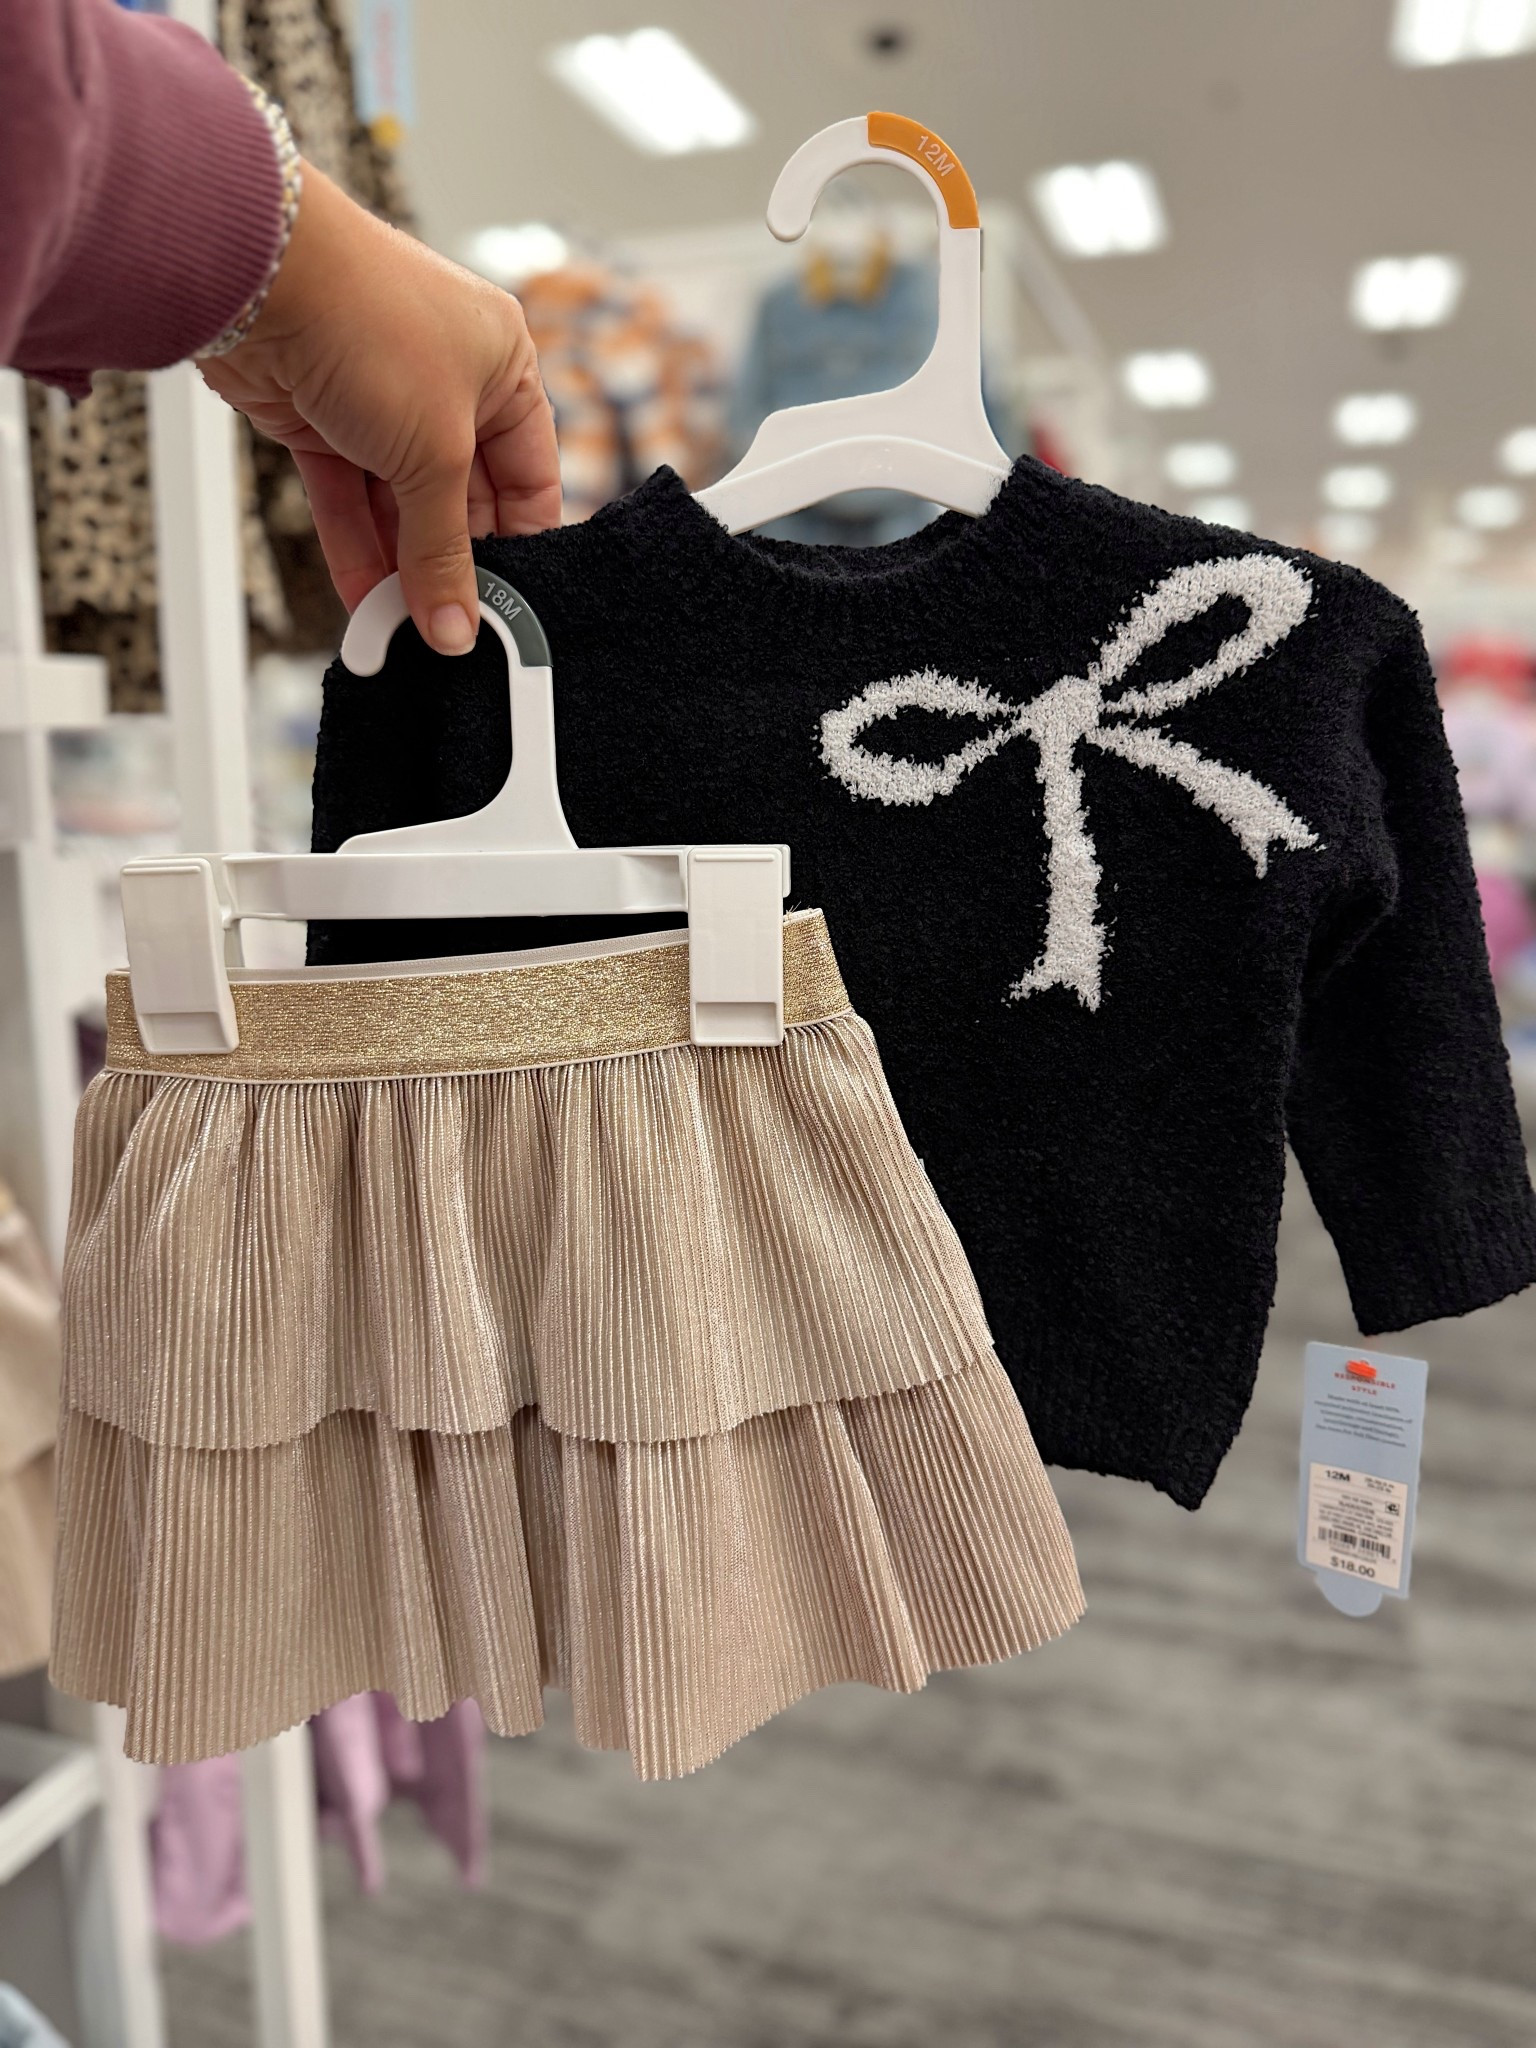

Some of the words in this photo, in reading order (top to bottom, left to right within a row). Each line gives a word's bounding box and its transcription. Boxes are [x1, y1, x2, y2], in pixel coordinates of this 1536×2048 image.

[917, 136, 956, 177] 12M
[485, 582, 522, 620] 18M
[1351, 1385, 1377, 1395] STYLE
[1325, 1470, 1350, 1482] 12M
[1330, 1556, 1375, 1578] $18.00
